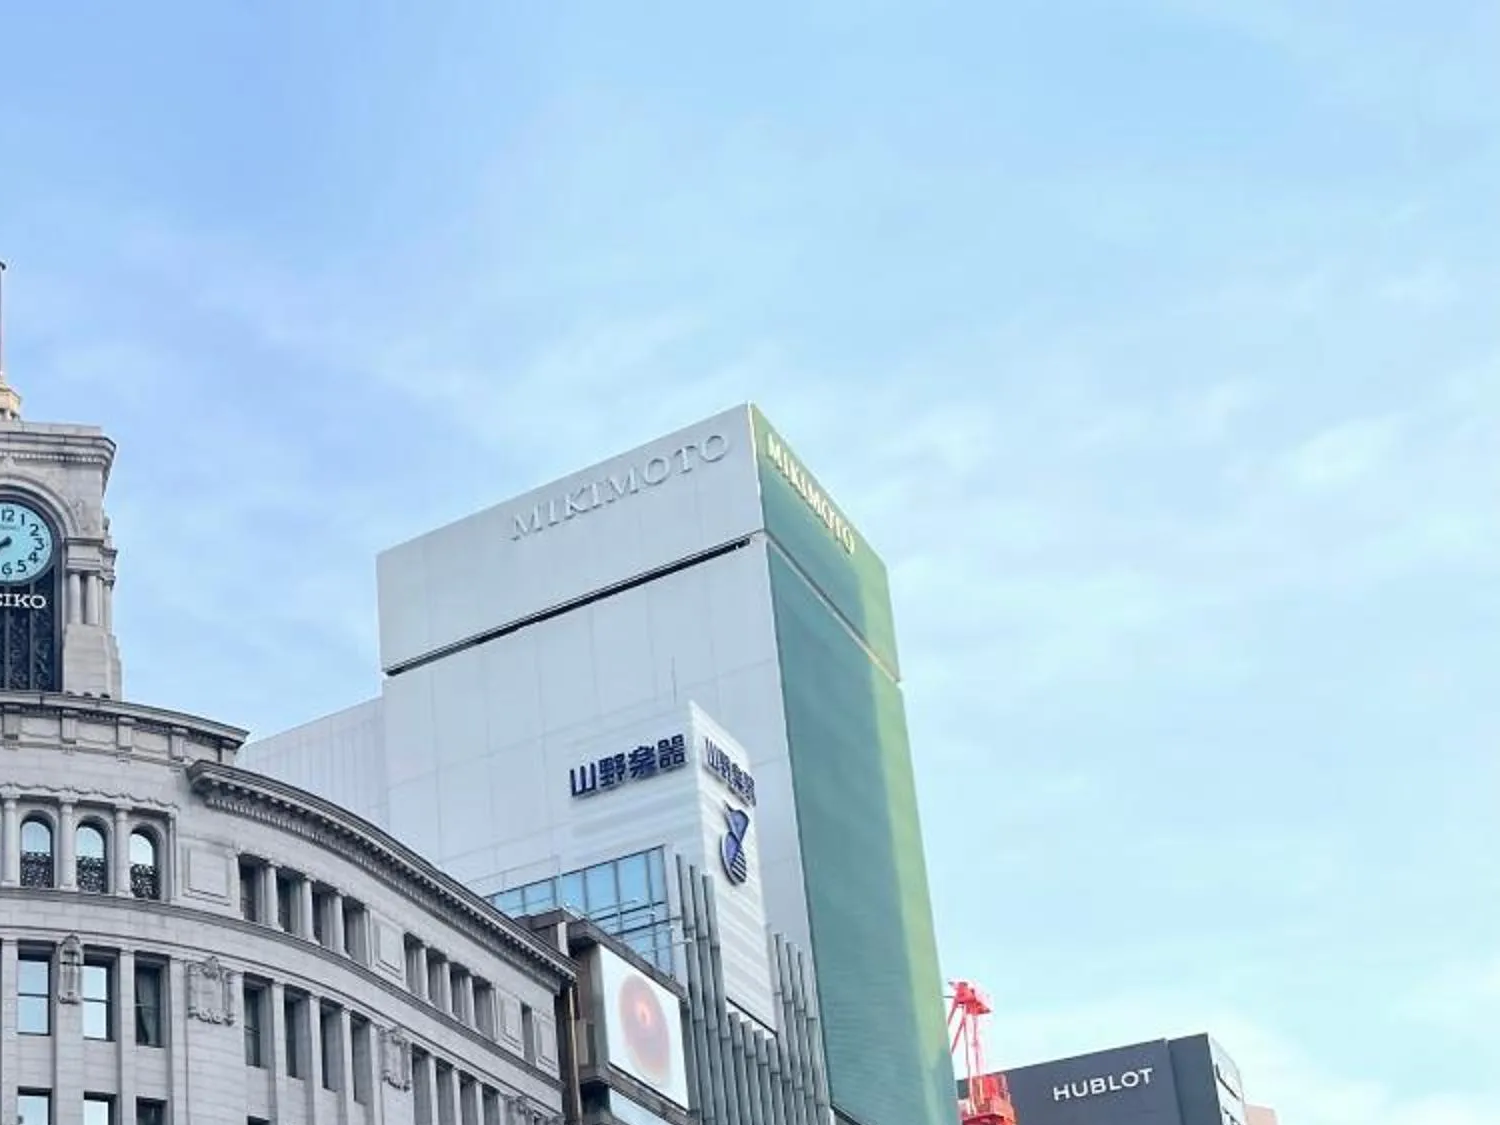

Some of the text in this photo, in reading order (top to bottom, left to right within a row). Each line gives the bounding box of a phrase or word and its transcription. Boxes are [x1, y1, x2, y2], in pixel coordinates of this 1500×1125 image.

[511, 434, 729, 541] MIKIMOTO
[766, 432, 855, 555] MIKIMOTO
[1, 509, 14, 522] 12
[29, 523, 39, 536] 2
[34, 537, 45, 551] 3
[28, 551, 39, 564] 4
[1, 561, 12, 575] 6
[15, 559, 27, 573] 5
[569, 734, 687, 798] 山野楽器
[1053, 1067, 1153, 1102] HUBLOT
